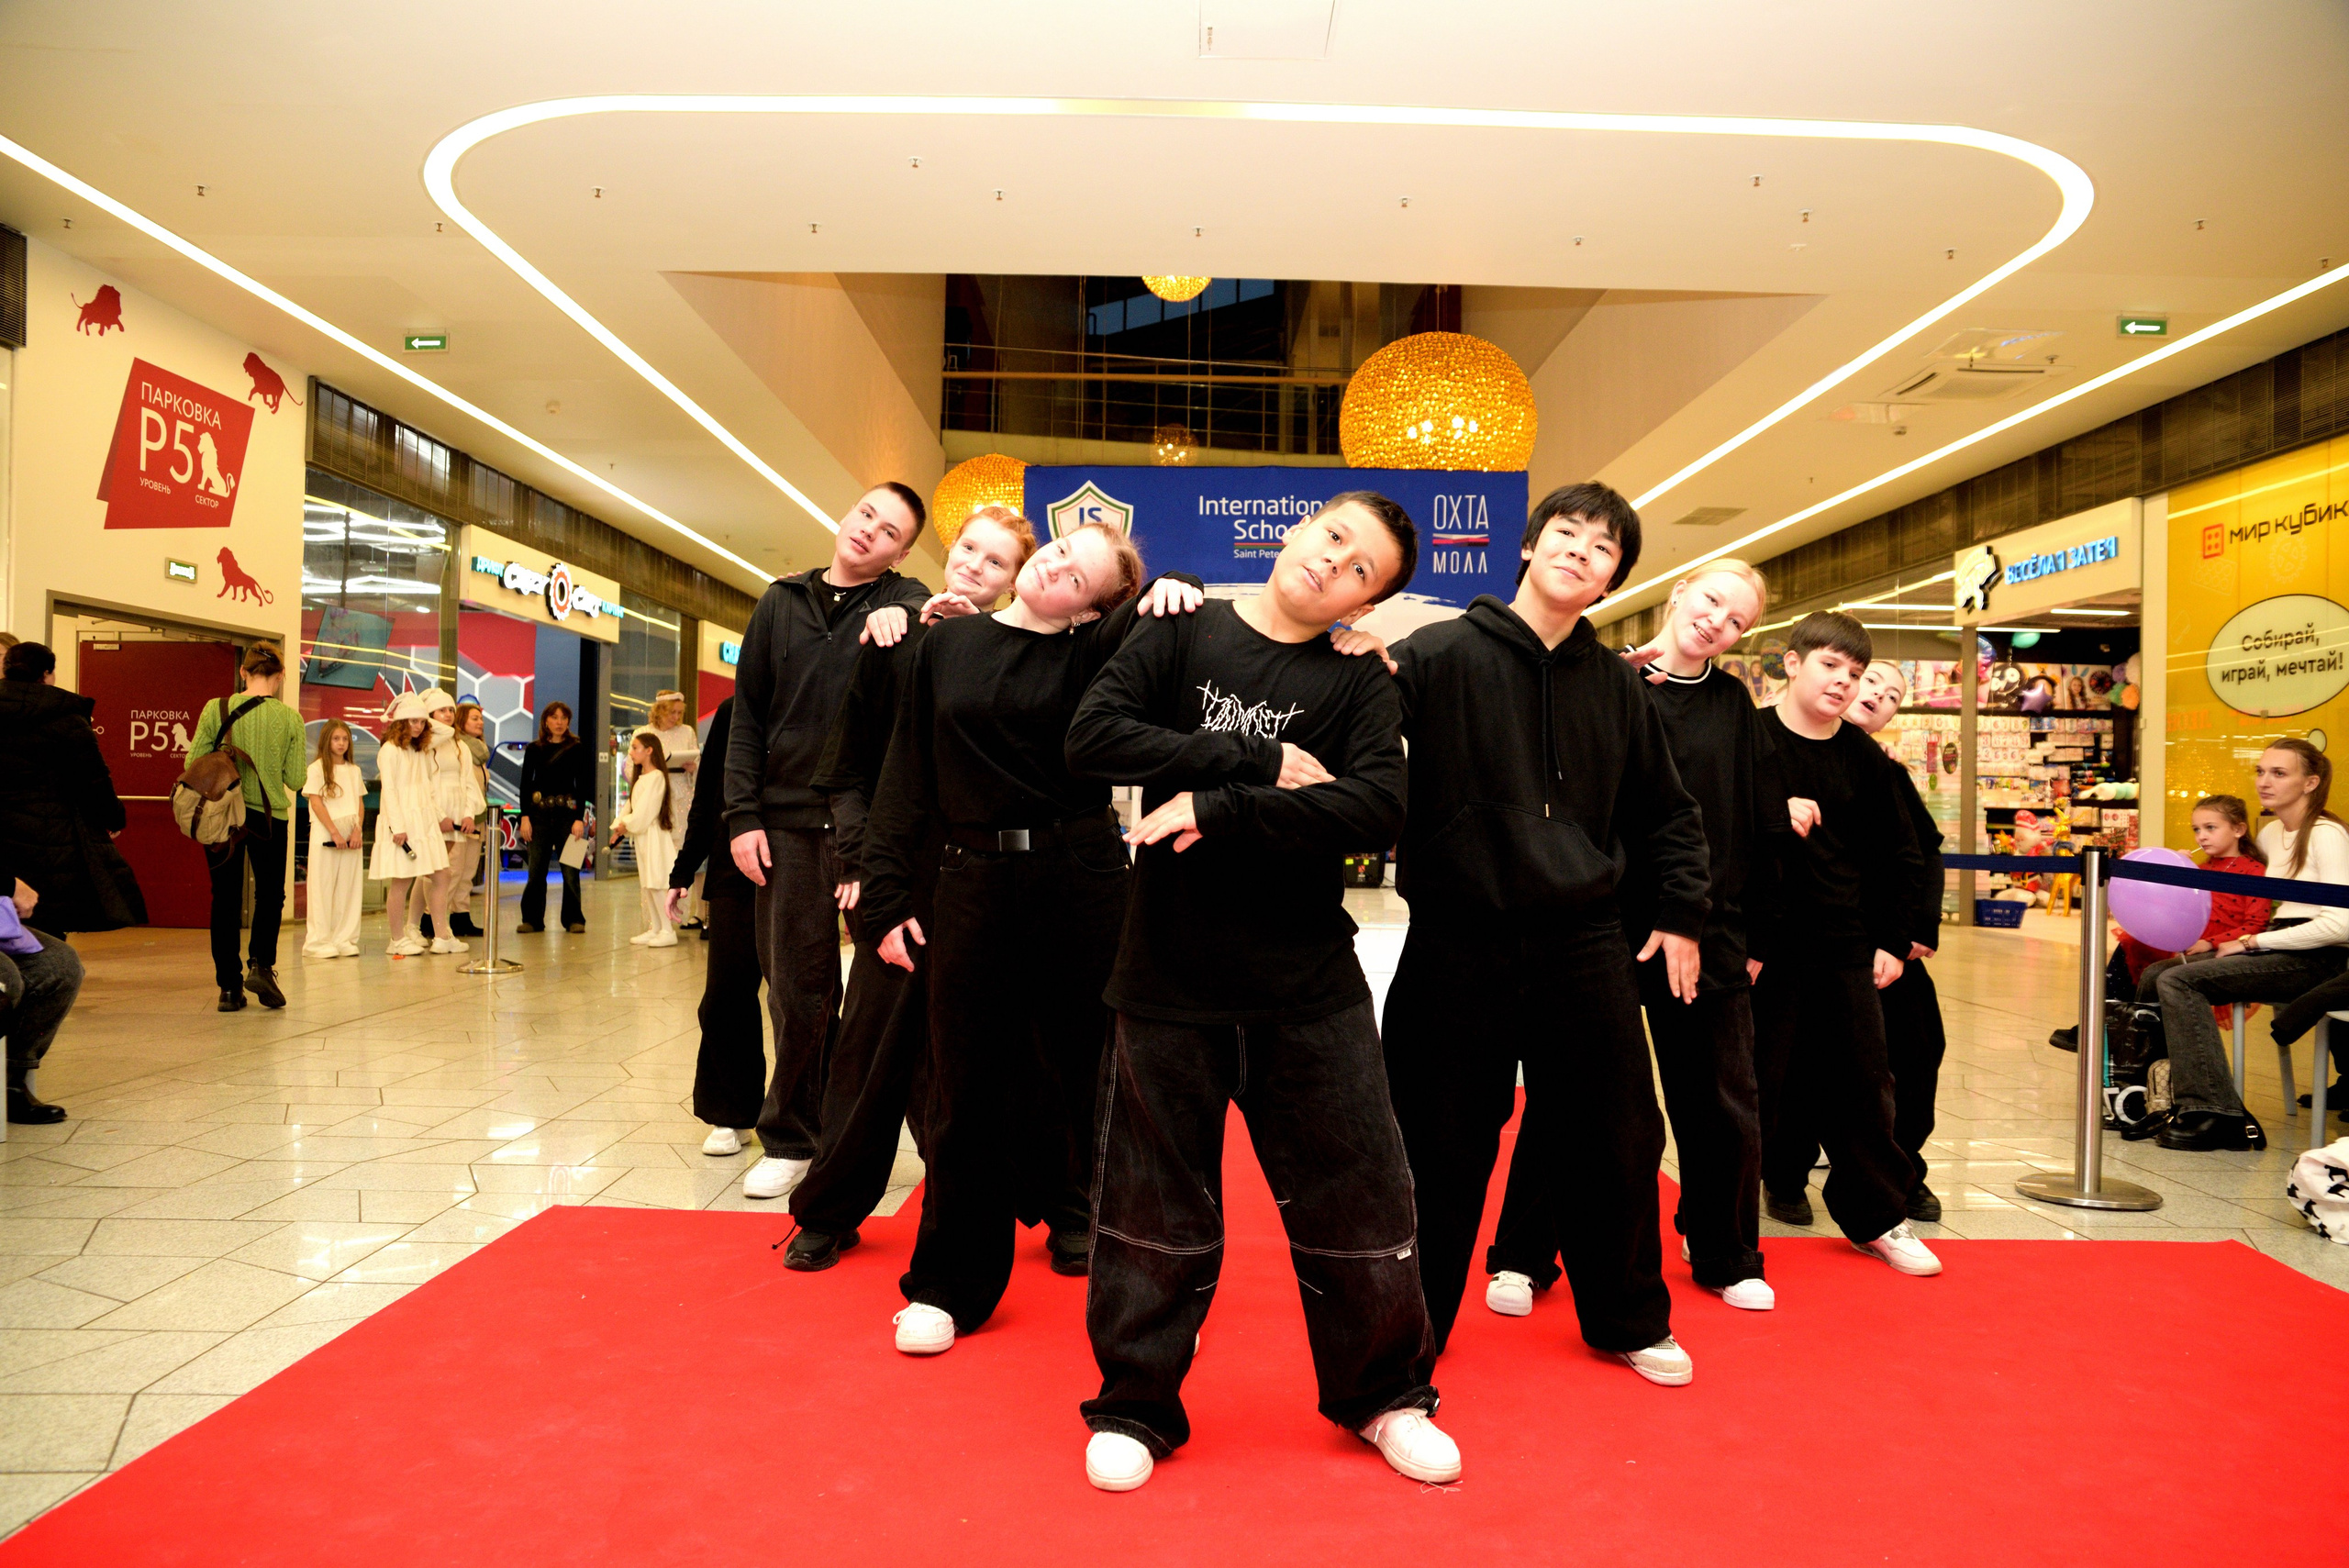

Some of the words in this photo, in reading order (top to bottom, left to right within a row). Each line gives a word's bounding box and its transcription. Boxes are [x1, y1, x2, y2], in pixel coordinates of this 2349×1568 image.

[141, 381, 221, 431] ПАРКОВКА
[139, 406, 195, 484] P5
[139, 476, 172, 495] УРОВЕНЬ
[195, 495, 219, 508] СЕКТОР
[1198, 495, 1331, 516] Internation
[1433, 494, 1489, 529] ОХТА
[1233, 519, 1288, 539] Scho
[2275, 500, 2349, 536] кубик
[1233, 549, 1257, 559] Saint
[1259, 549, 1280, 559] Pete
[2004, 552, 2066, 584] ВЕСЁЛАЯ
[2066, 536, 2118, 569] ЗАТЕЯ
[2242, 622, 2320, 651] Собирай,
[2221, 659, 2270, 685] играй,
[2276, 650, 2343, 677] мечтай!
[130, 709, 190, 720] ПАРКОВКА
[130, 721, 169, 751] P5
